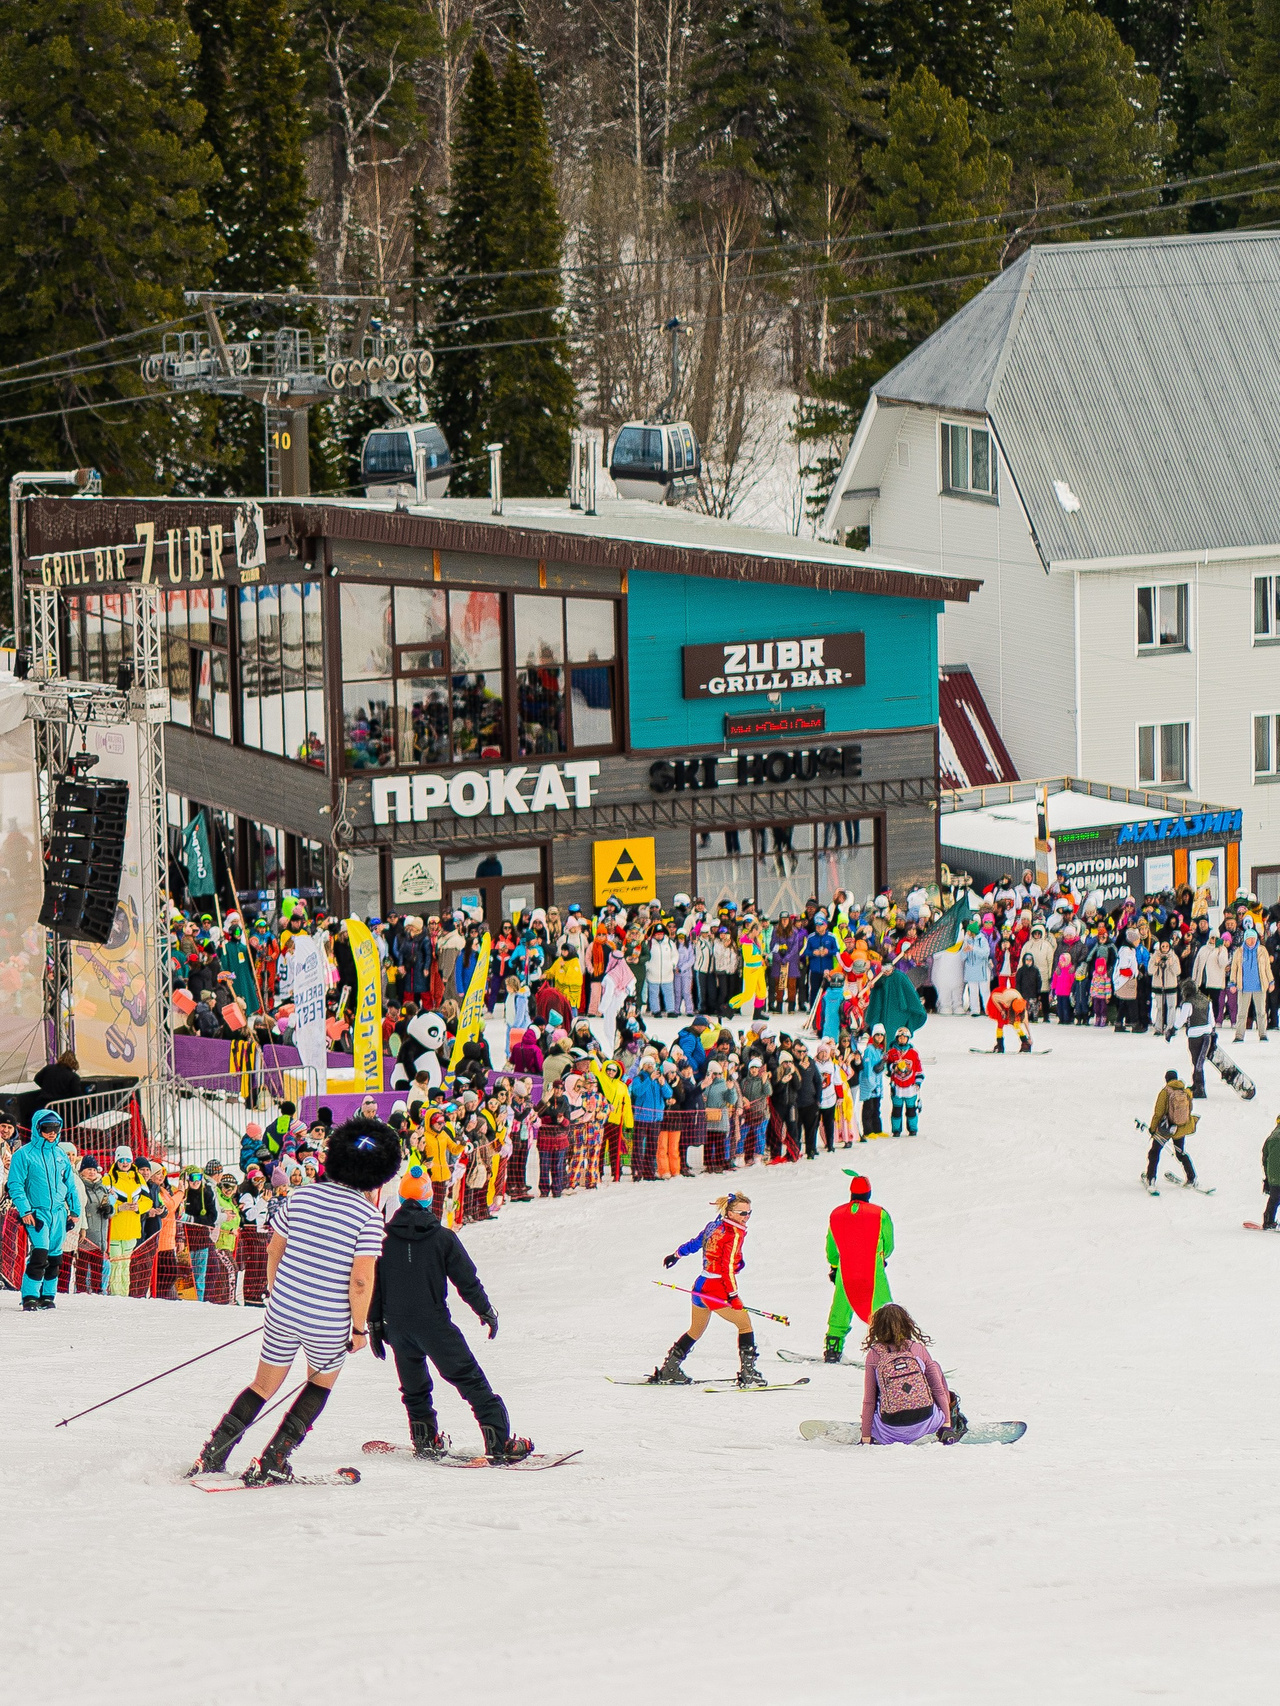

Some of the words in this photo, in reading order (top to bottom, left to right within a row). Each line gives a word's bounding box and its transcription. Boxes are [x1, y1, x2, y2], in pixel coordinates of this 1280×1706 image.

[272, 432, 291, 450] 10
[41, 554, 89, 587] GRILL
[94, 547, 127, 582] BAR
[723, 638, 825, 675] ZUBR
[649, 757, 719, 793] SKI
[737, 744, 862, 786] HOUSE
[372, 760, 601, 825] ПРОКАТ
[1117, 808, 1243, 846] МАГАЗИН
